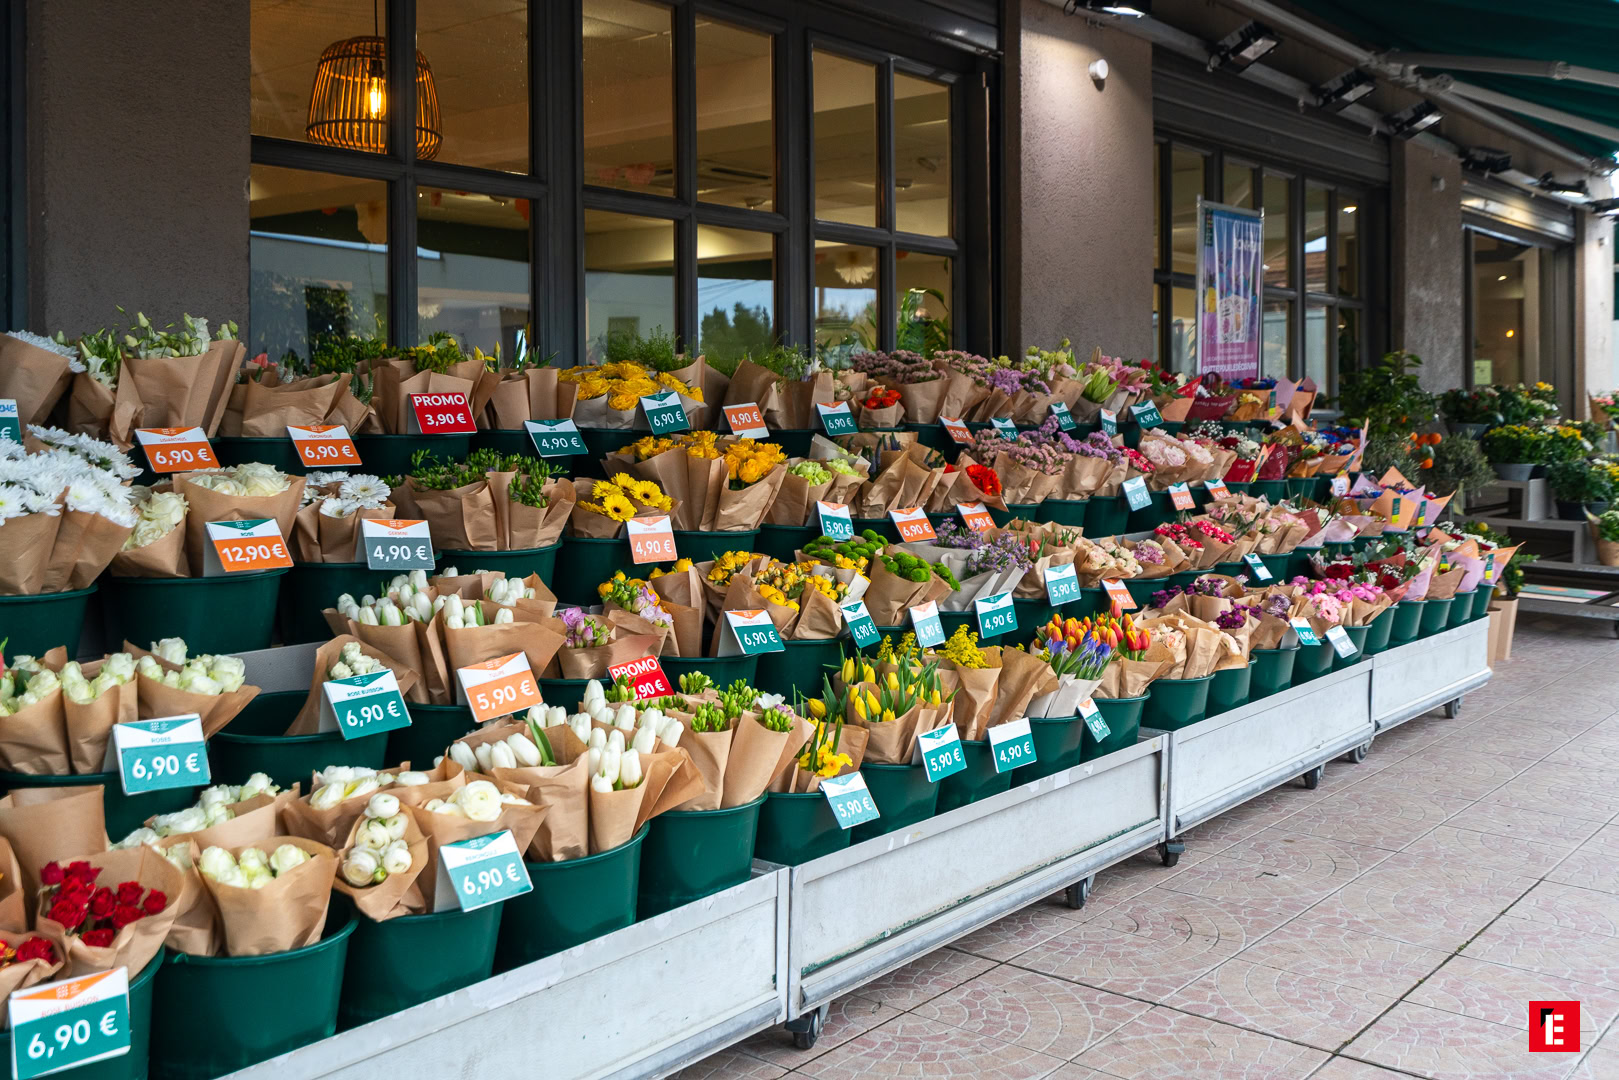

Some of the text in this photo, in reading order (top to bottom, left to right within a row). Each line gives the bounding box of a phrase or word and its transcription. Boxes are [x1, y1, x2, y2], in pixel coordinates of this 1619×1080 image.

[413, 394, 465, 407] PROMO
[425, 413, 467, 427] 3,90 €
[654, 410, 684, 427] 6,90 €
[731, 411, 761, 426] 4,90 €
[828, 416, 853, 430] 6,90 €
[1140, 412, 1159, 424] 4,90 €
[541, 437, 581, 450] 4,90 €
[965, 431, 972, 441] €
[155, 448, 211, 466] 6,90 €
[305, 445, 354, 460] 6,90 €
[1143, 491, 1149, 500] €
[826, 521, 852, 536] 5,90 €
[903, 522, 932, 537] 6,90 €
[985, 516, 993, 527] €
[222, 543, 287, 564] 12,90 €
[373, 545, 429, 562] 4,90 €
[636, 539, 672, 556] 4,90 €
[1052, 581, 1078, 597] 5,90 €
[985, 611, 1014, 630] 4,90 €
[744, 630, 778, 647] 6,90 €
[855, 622, 876, 640] 6,90 €
[920, 622, 942, 640] 4,90 €
[612, 658, 658, 680] PROMO
[476, 679, 535, 711] 5,90 €
[634, 678, 666, 699] ,90 €
[346, 700, 401, 727] 6,90 €
[930, 747, 962, 772] 5,90 €
[1000, 741, 1032, 764] 4,90 €
[132, 752, 200, 781] 6,90 €
[837, 796, 873, 818] 5,90 €
[463, 863, 521, 895] 6,90 €
[28, 1010, 119, 1060] 6,90 €
